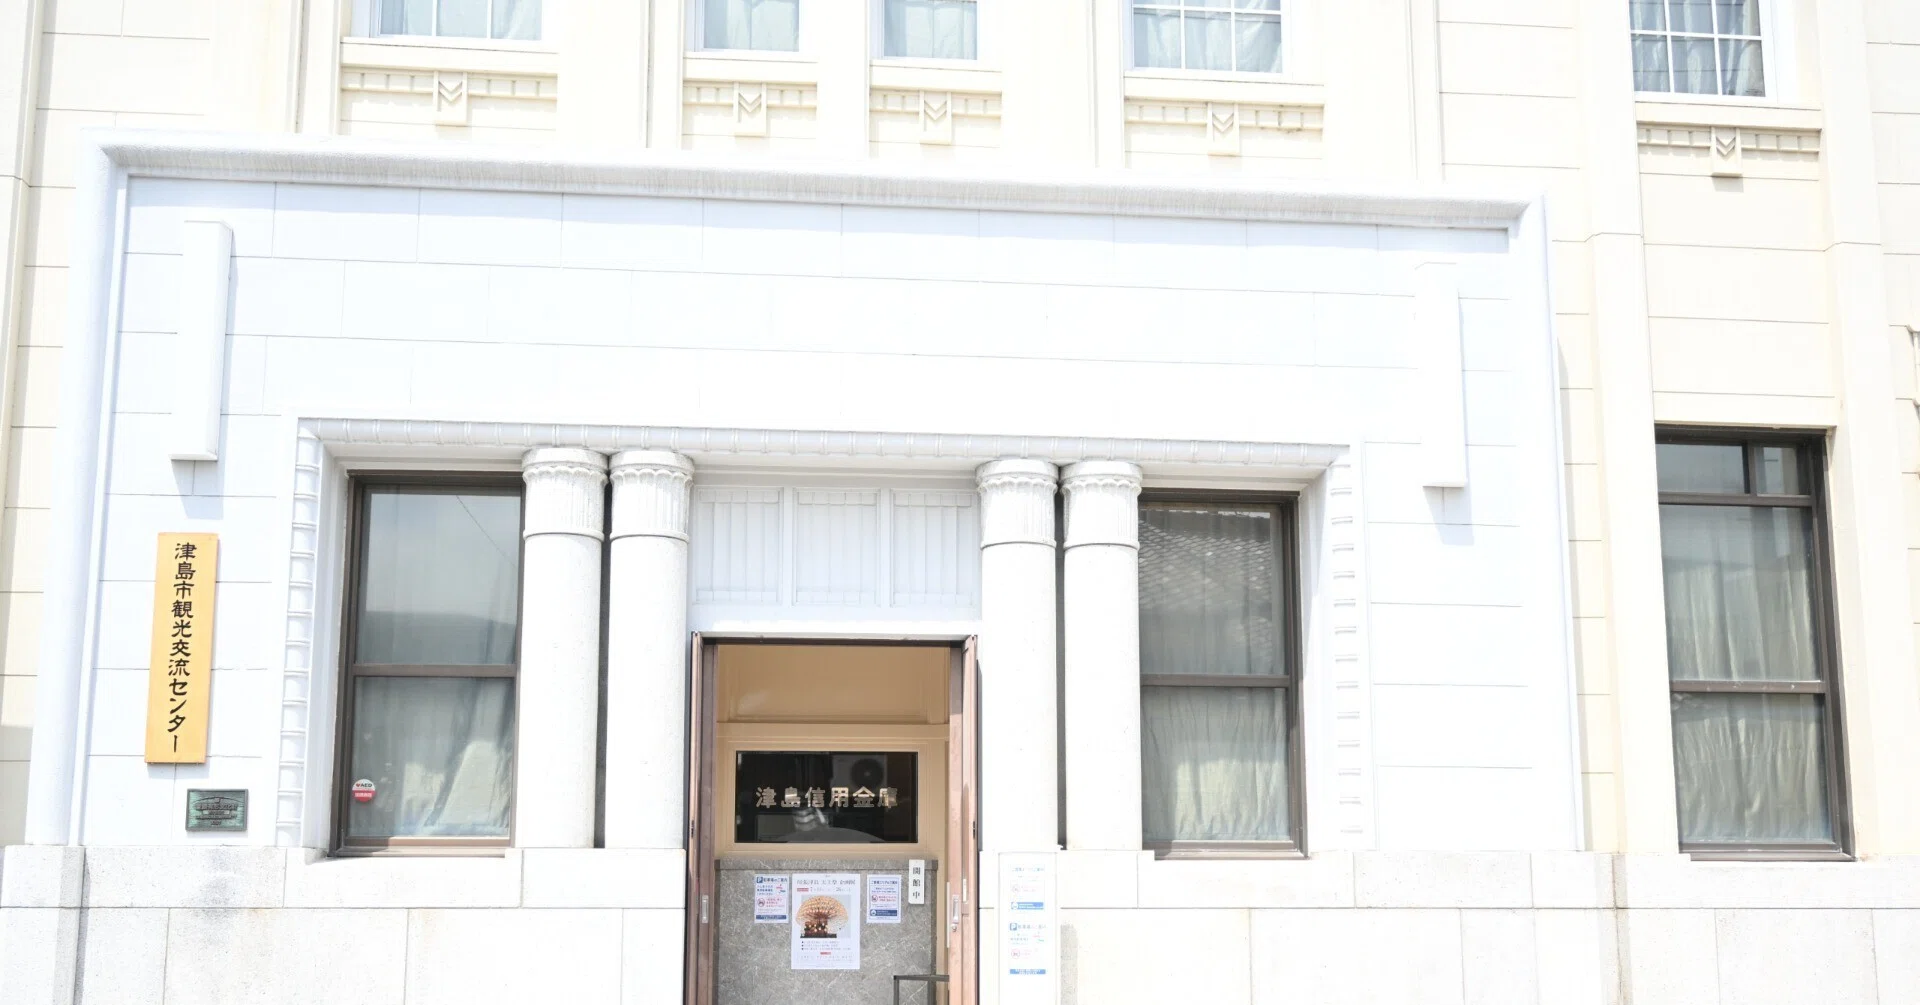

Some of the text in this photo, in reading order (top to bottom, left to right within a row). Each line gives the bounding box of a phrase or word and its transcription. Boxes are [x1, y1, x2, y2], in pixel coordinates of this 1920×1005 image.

[167, 542, 197, 753] 津島市観光交流センター
[756, 786, 898, 808] 津島信用金庫
[912, 866, 921, 899] 開館中
